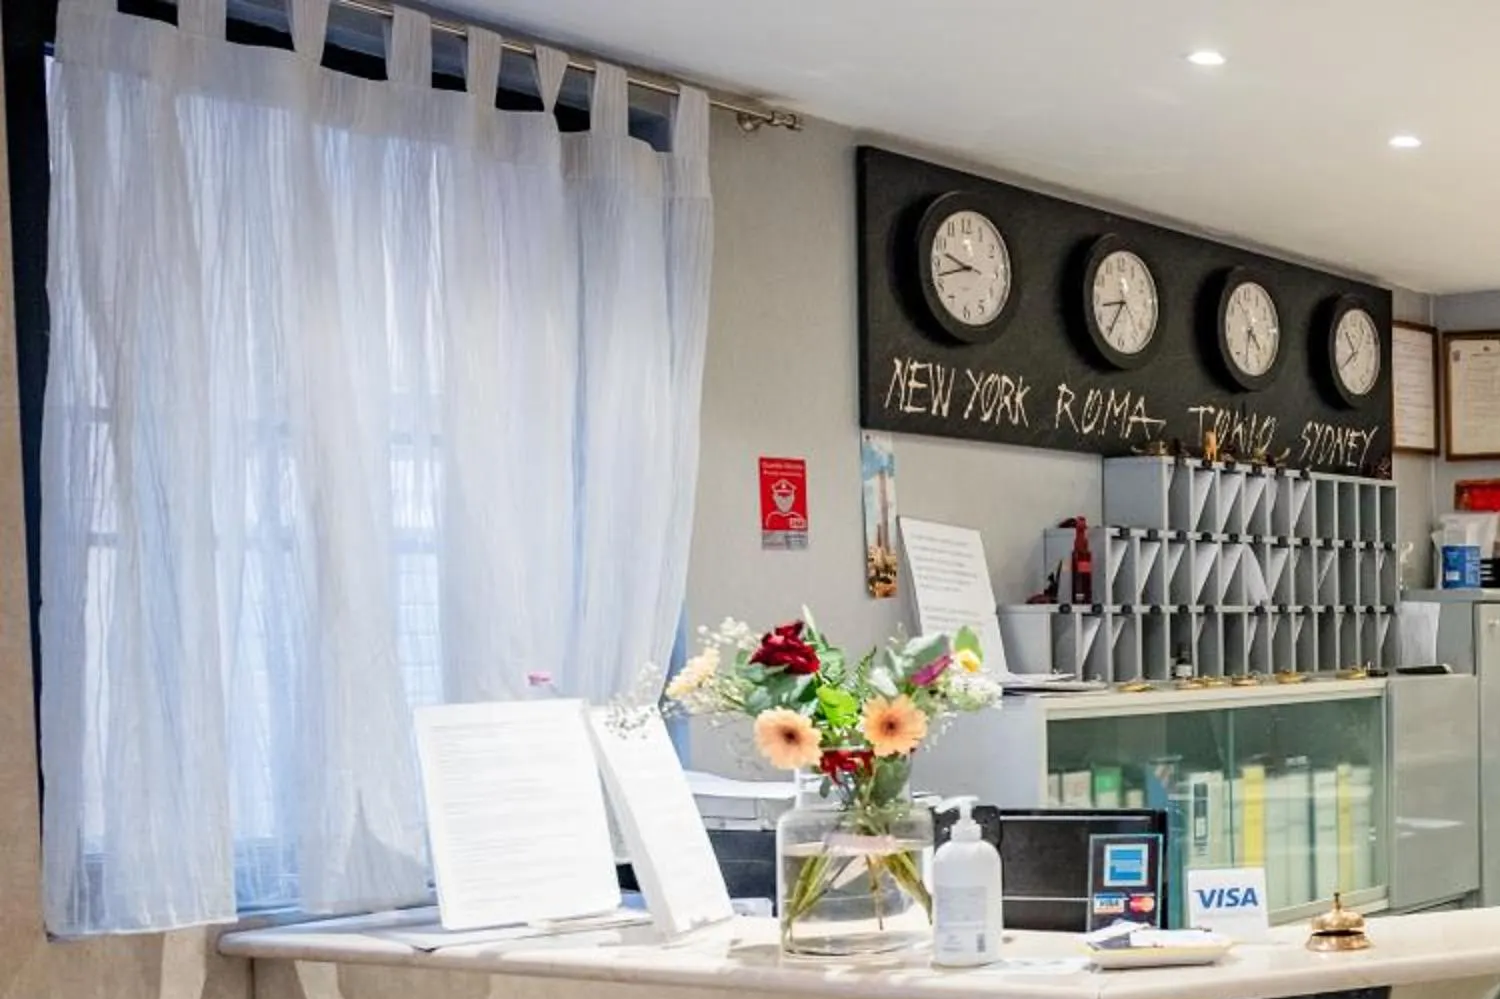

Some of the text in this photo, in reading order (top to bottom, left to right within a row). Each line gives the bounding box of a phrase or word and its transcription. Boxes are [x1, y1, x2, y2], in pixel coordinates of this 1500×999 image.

[885, 357, 1030, 427] NEW YORK
[1056, 382, 1167, 440] ROMA
[1300, 420, 1379, 468] SYDNEY
[1192, 887, 1258, 909] VISA
